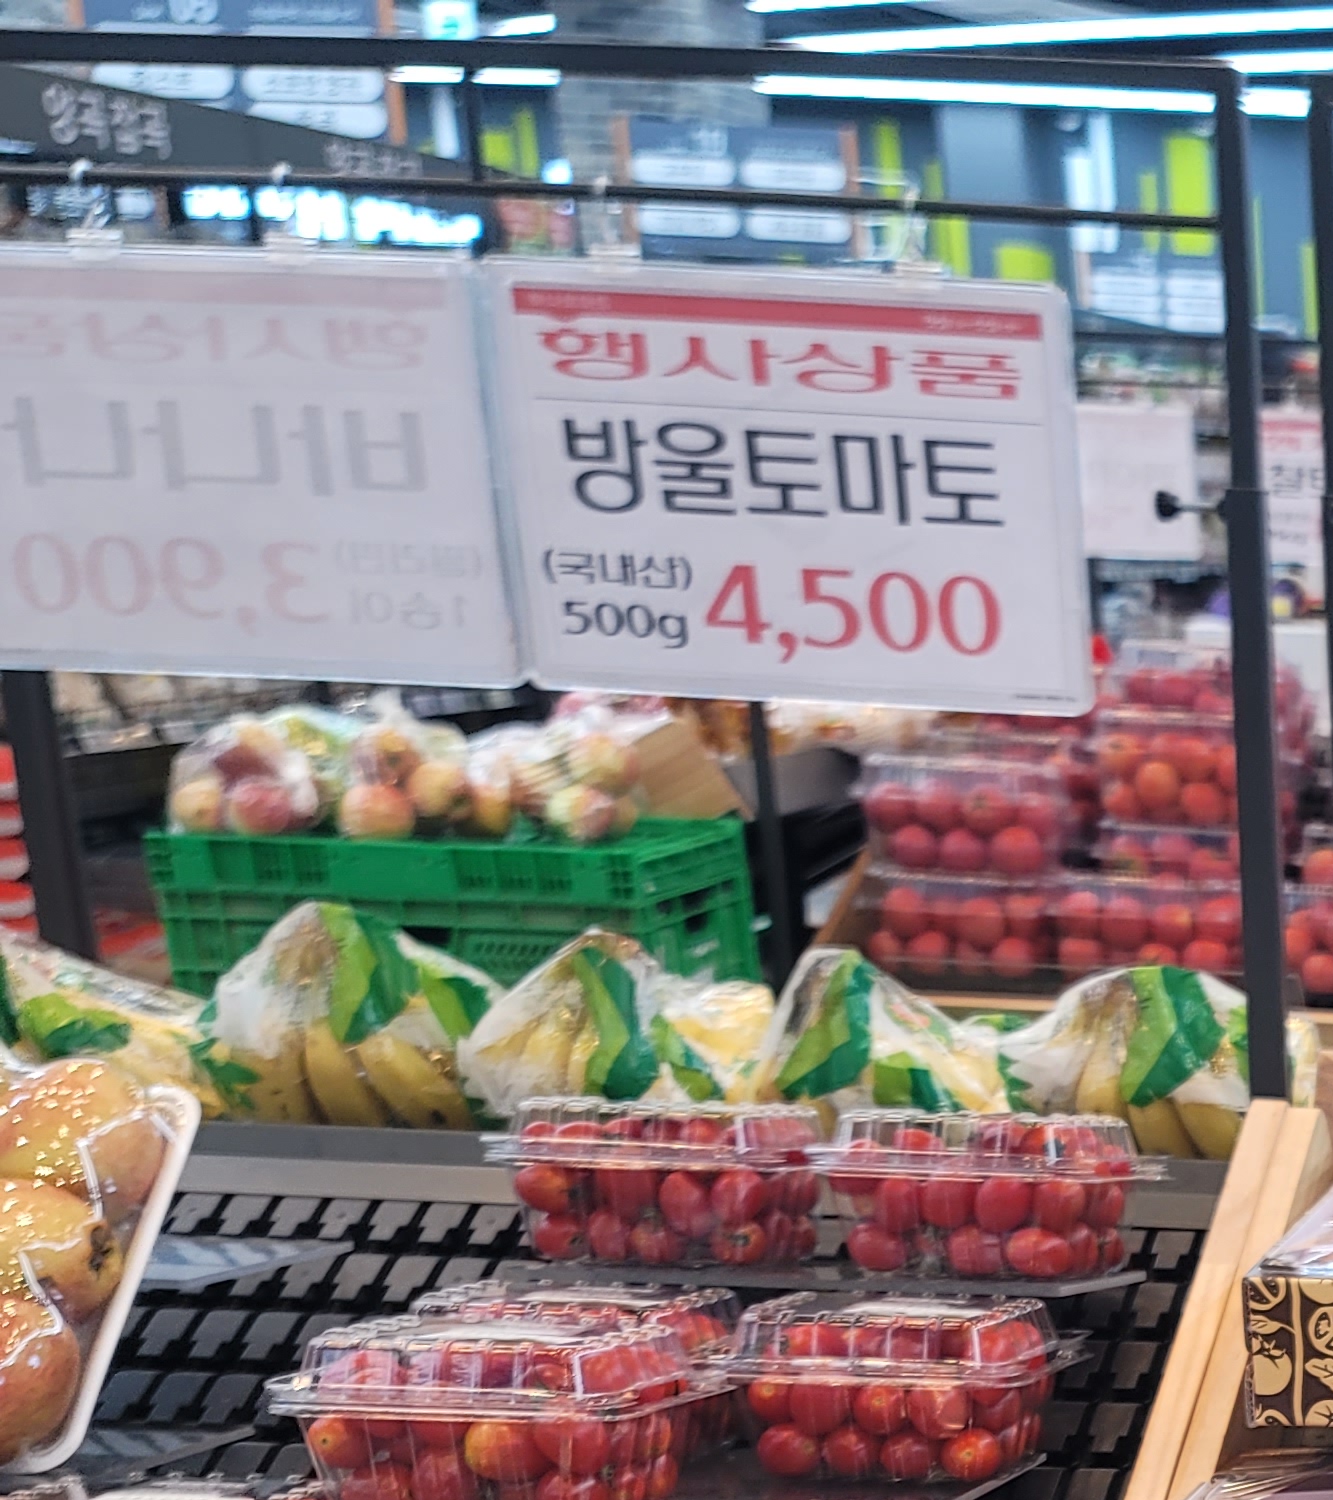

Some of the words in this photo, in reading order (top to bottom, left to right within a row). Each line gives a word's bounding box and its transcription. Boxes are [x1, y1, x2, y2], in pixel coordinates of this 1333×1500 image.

[540, 327, 1020, 400] 행사상품
[564, 418, 1004, 526] 방울토마토
[543, 549, 693, 590] (국내산)
[563, 601, 690, 648] 500g
[706, 564, 1003, 663] 4,500
